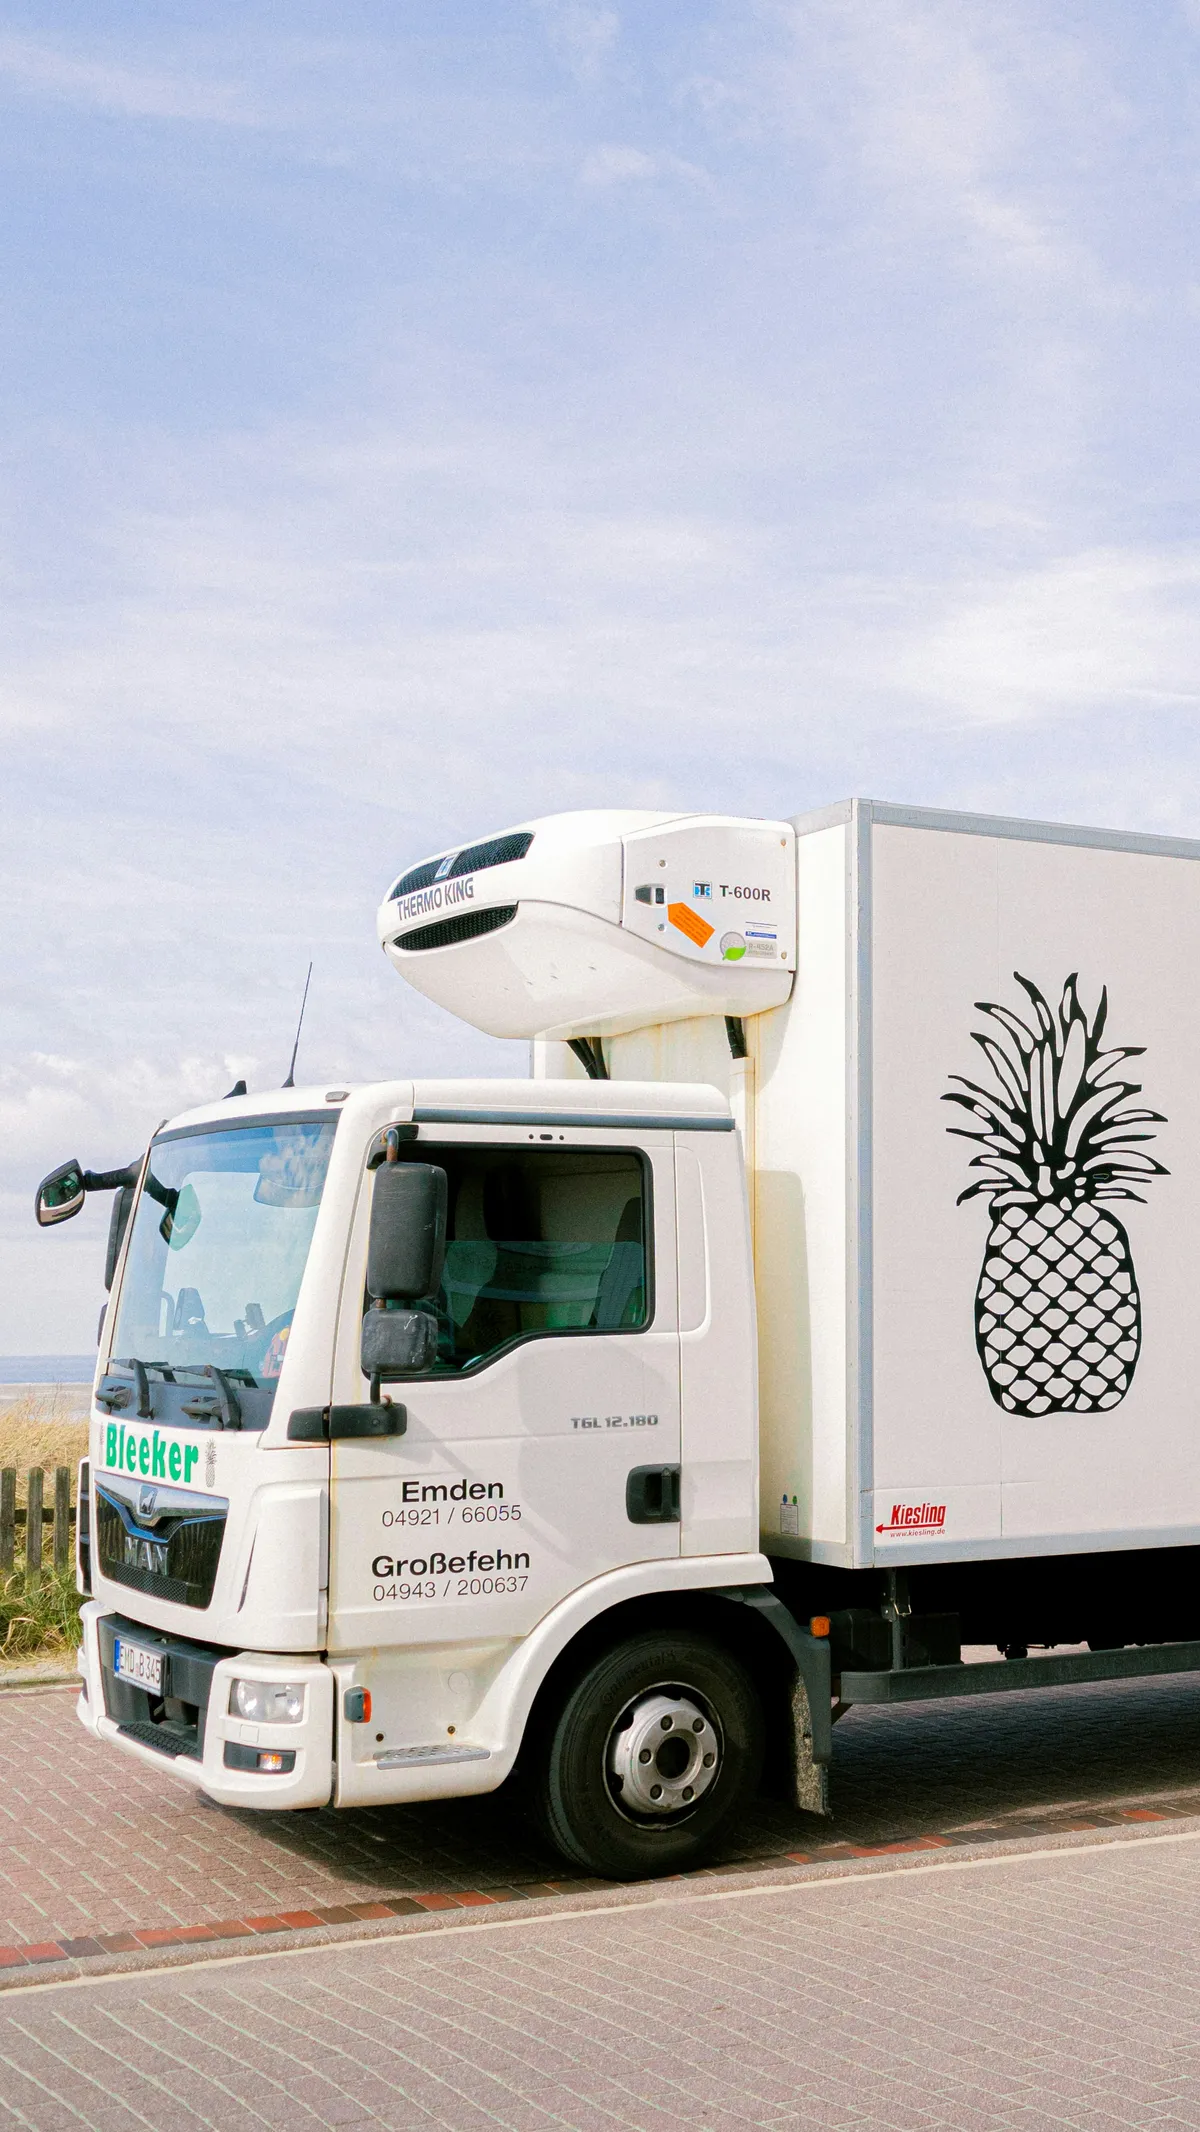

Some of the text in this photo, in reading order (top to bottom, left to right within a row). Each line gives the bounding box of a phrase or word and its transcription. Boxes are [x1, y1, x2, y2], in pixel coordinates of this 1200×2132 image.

[397, 877, 475, 921] THERMO KING
[719, 884, 771, 902] T-600R
[570, 1414, 659, 1429] TGL 12.180
[105, 1422, 199, 1484] Bleeker
[401, 1478, 504, 1503] Emden
[381, 1504, 522, 1527] 04921 / 66055
[890, 1502, 947, 1526] Kiesling
[890, 1528, 946, 1538] www.kiesling.de
[124, 1536, 169, 1576] MAN
[371, 1549, 530, 1578] Großefehn
[373, 1576, 529, 1602] 04943 / 200637
